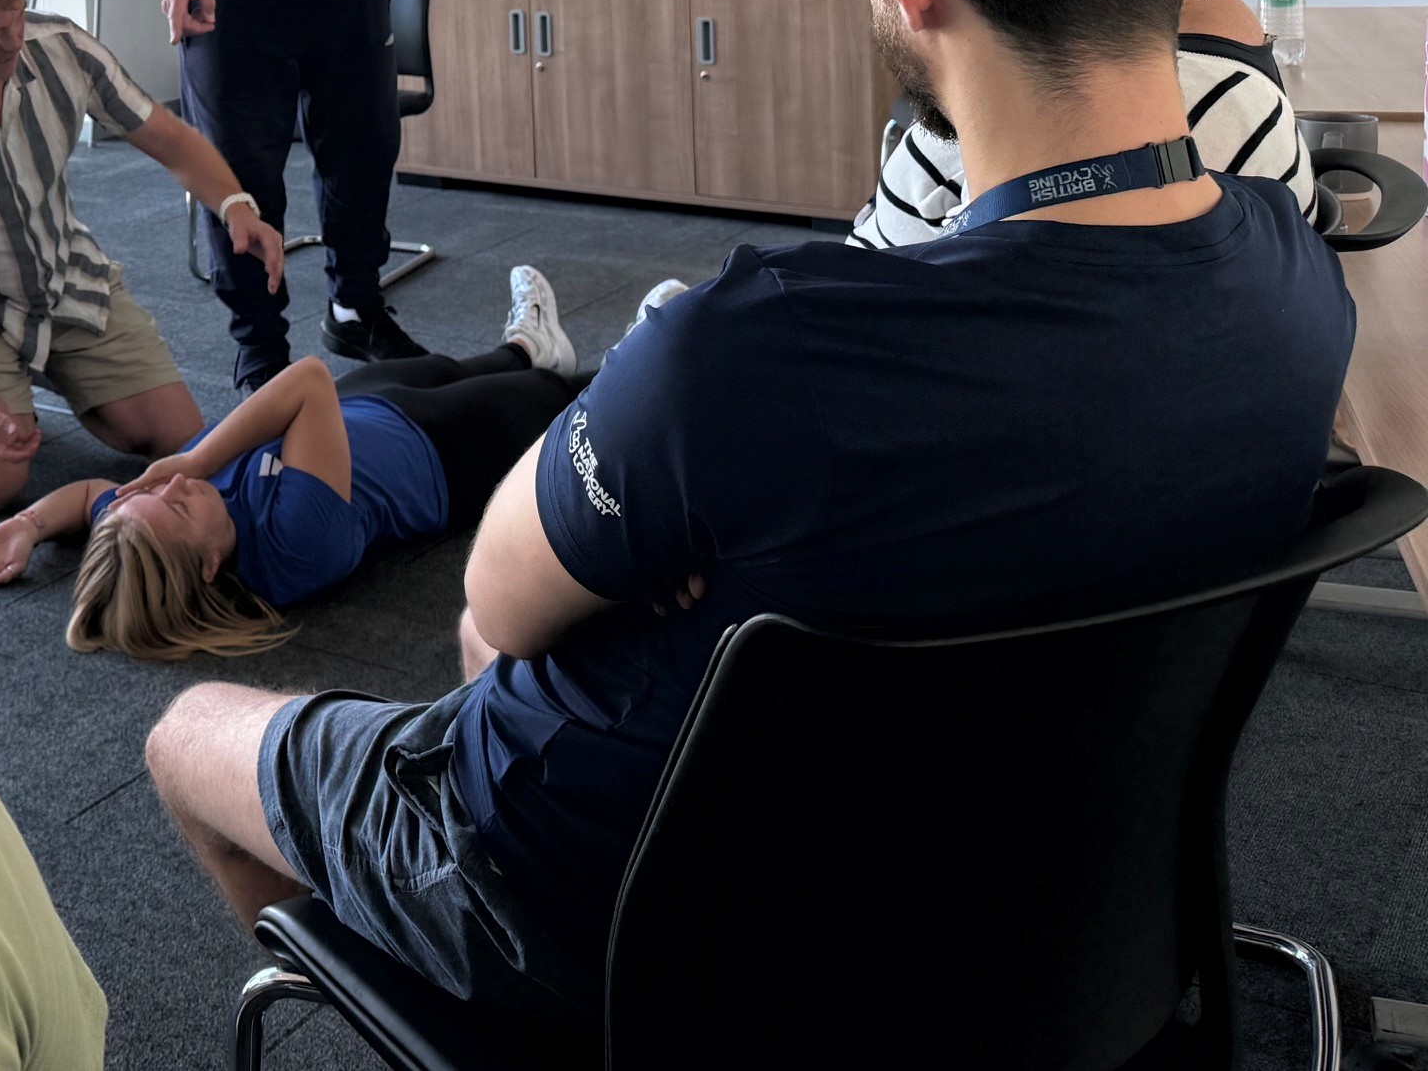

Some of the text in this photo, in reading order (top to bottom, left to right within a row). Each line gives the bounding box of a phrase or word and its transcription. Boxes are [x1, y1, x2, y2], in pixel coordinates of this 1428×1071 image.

[1028, 167, 1092, 192] CYCLING
[1031, 179, 1096, 203] BRITISH
[584, 437, 599, 470] THE
[573, 452, 614, 515] LOTTERY
[578, 445, 621, 517] NATIONAL
